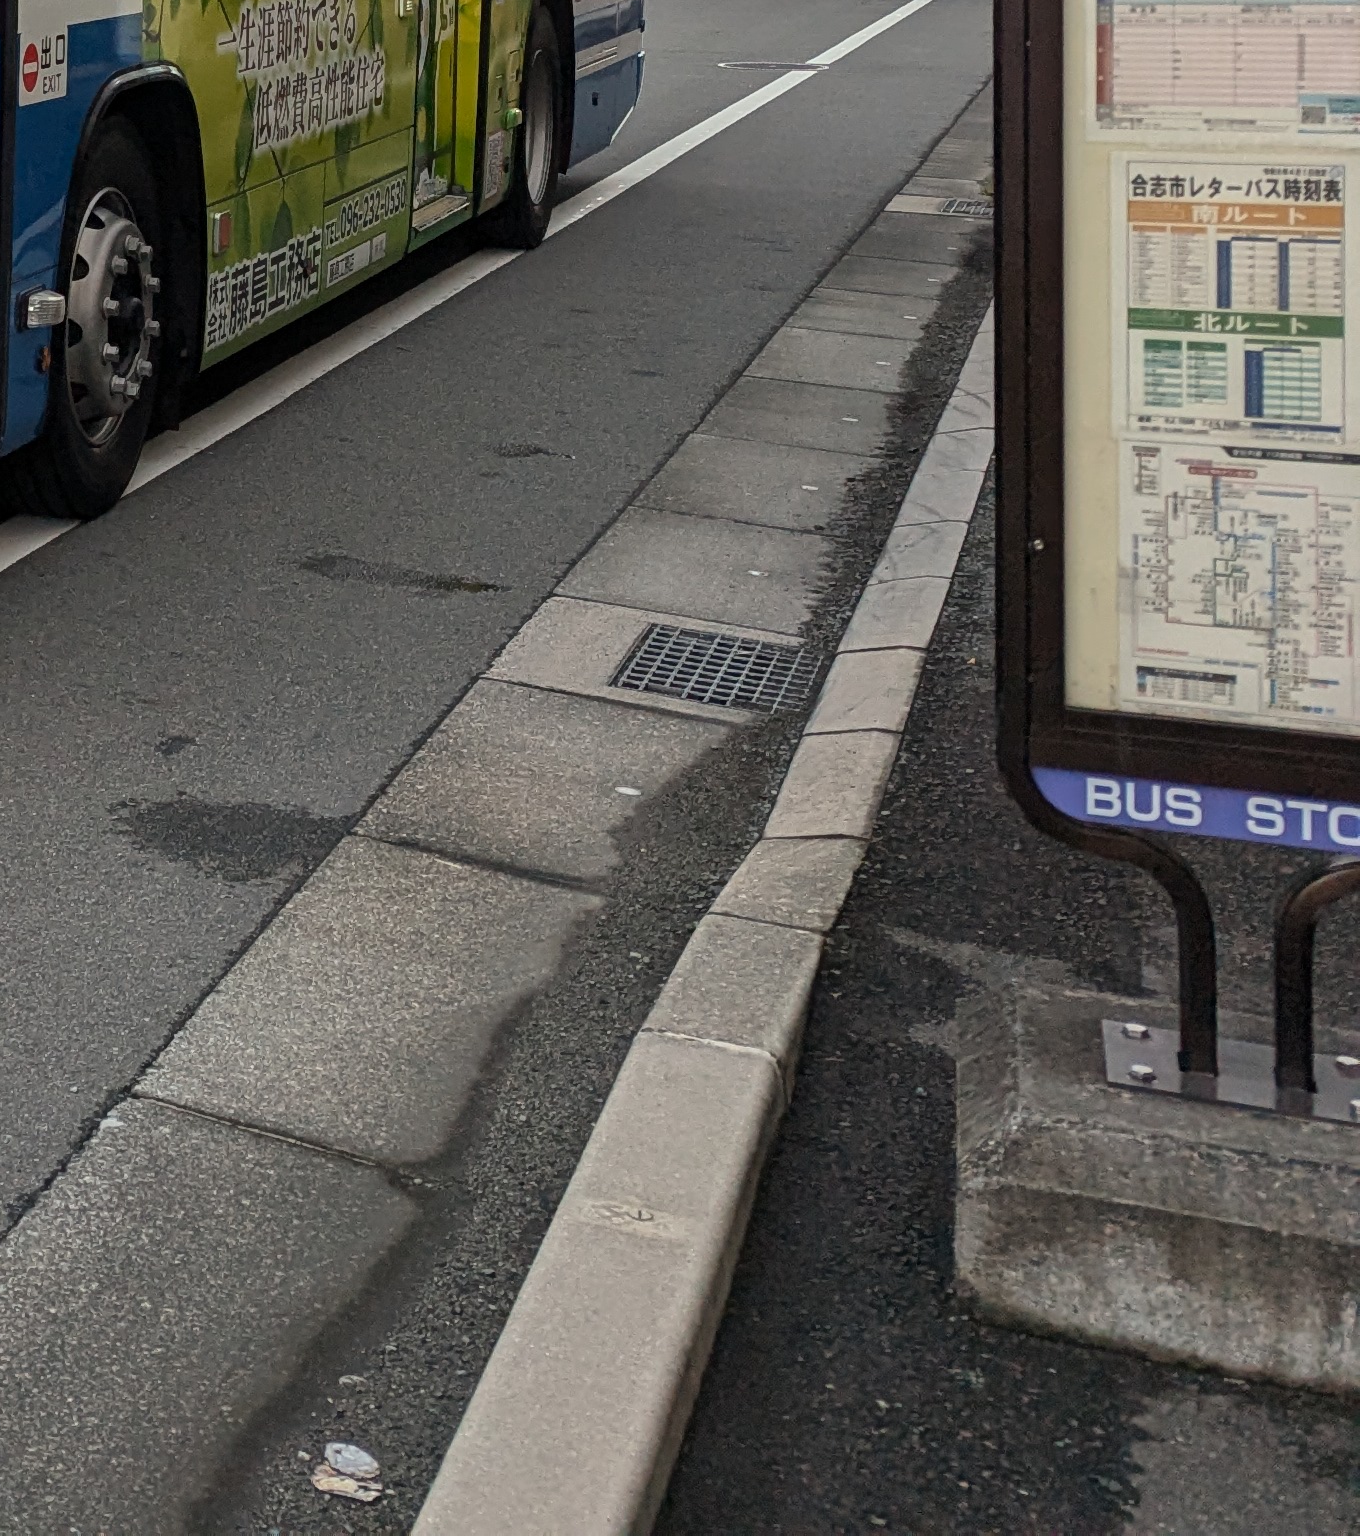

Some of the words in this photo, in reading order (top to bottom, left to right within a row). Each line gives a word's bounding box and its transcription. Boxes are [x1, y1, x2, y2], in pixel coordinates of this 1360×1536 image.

[41, 35, 66, 69] 出口
[43, 74, 62, 94] EXIT
[255, 51, 384, 149] 低燃費高性能住宅
[1130, 173, 1342, 203] 合志市レターバス時刻表
[1191, 205, 1307, 226] 南ルート
[210, 274, 230, 307] 株式
[207, 312, 228, 348] 会社
[1193, 312, 1310, 336] 北ルート
[1086, 777, 1202, 827] BUS
